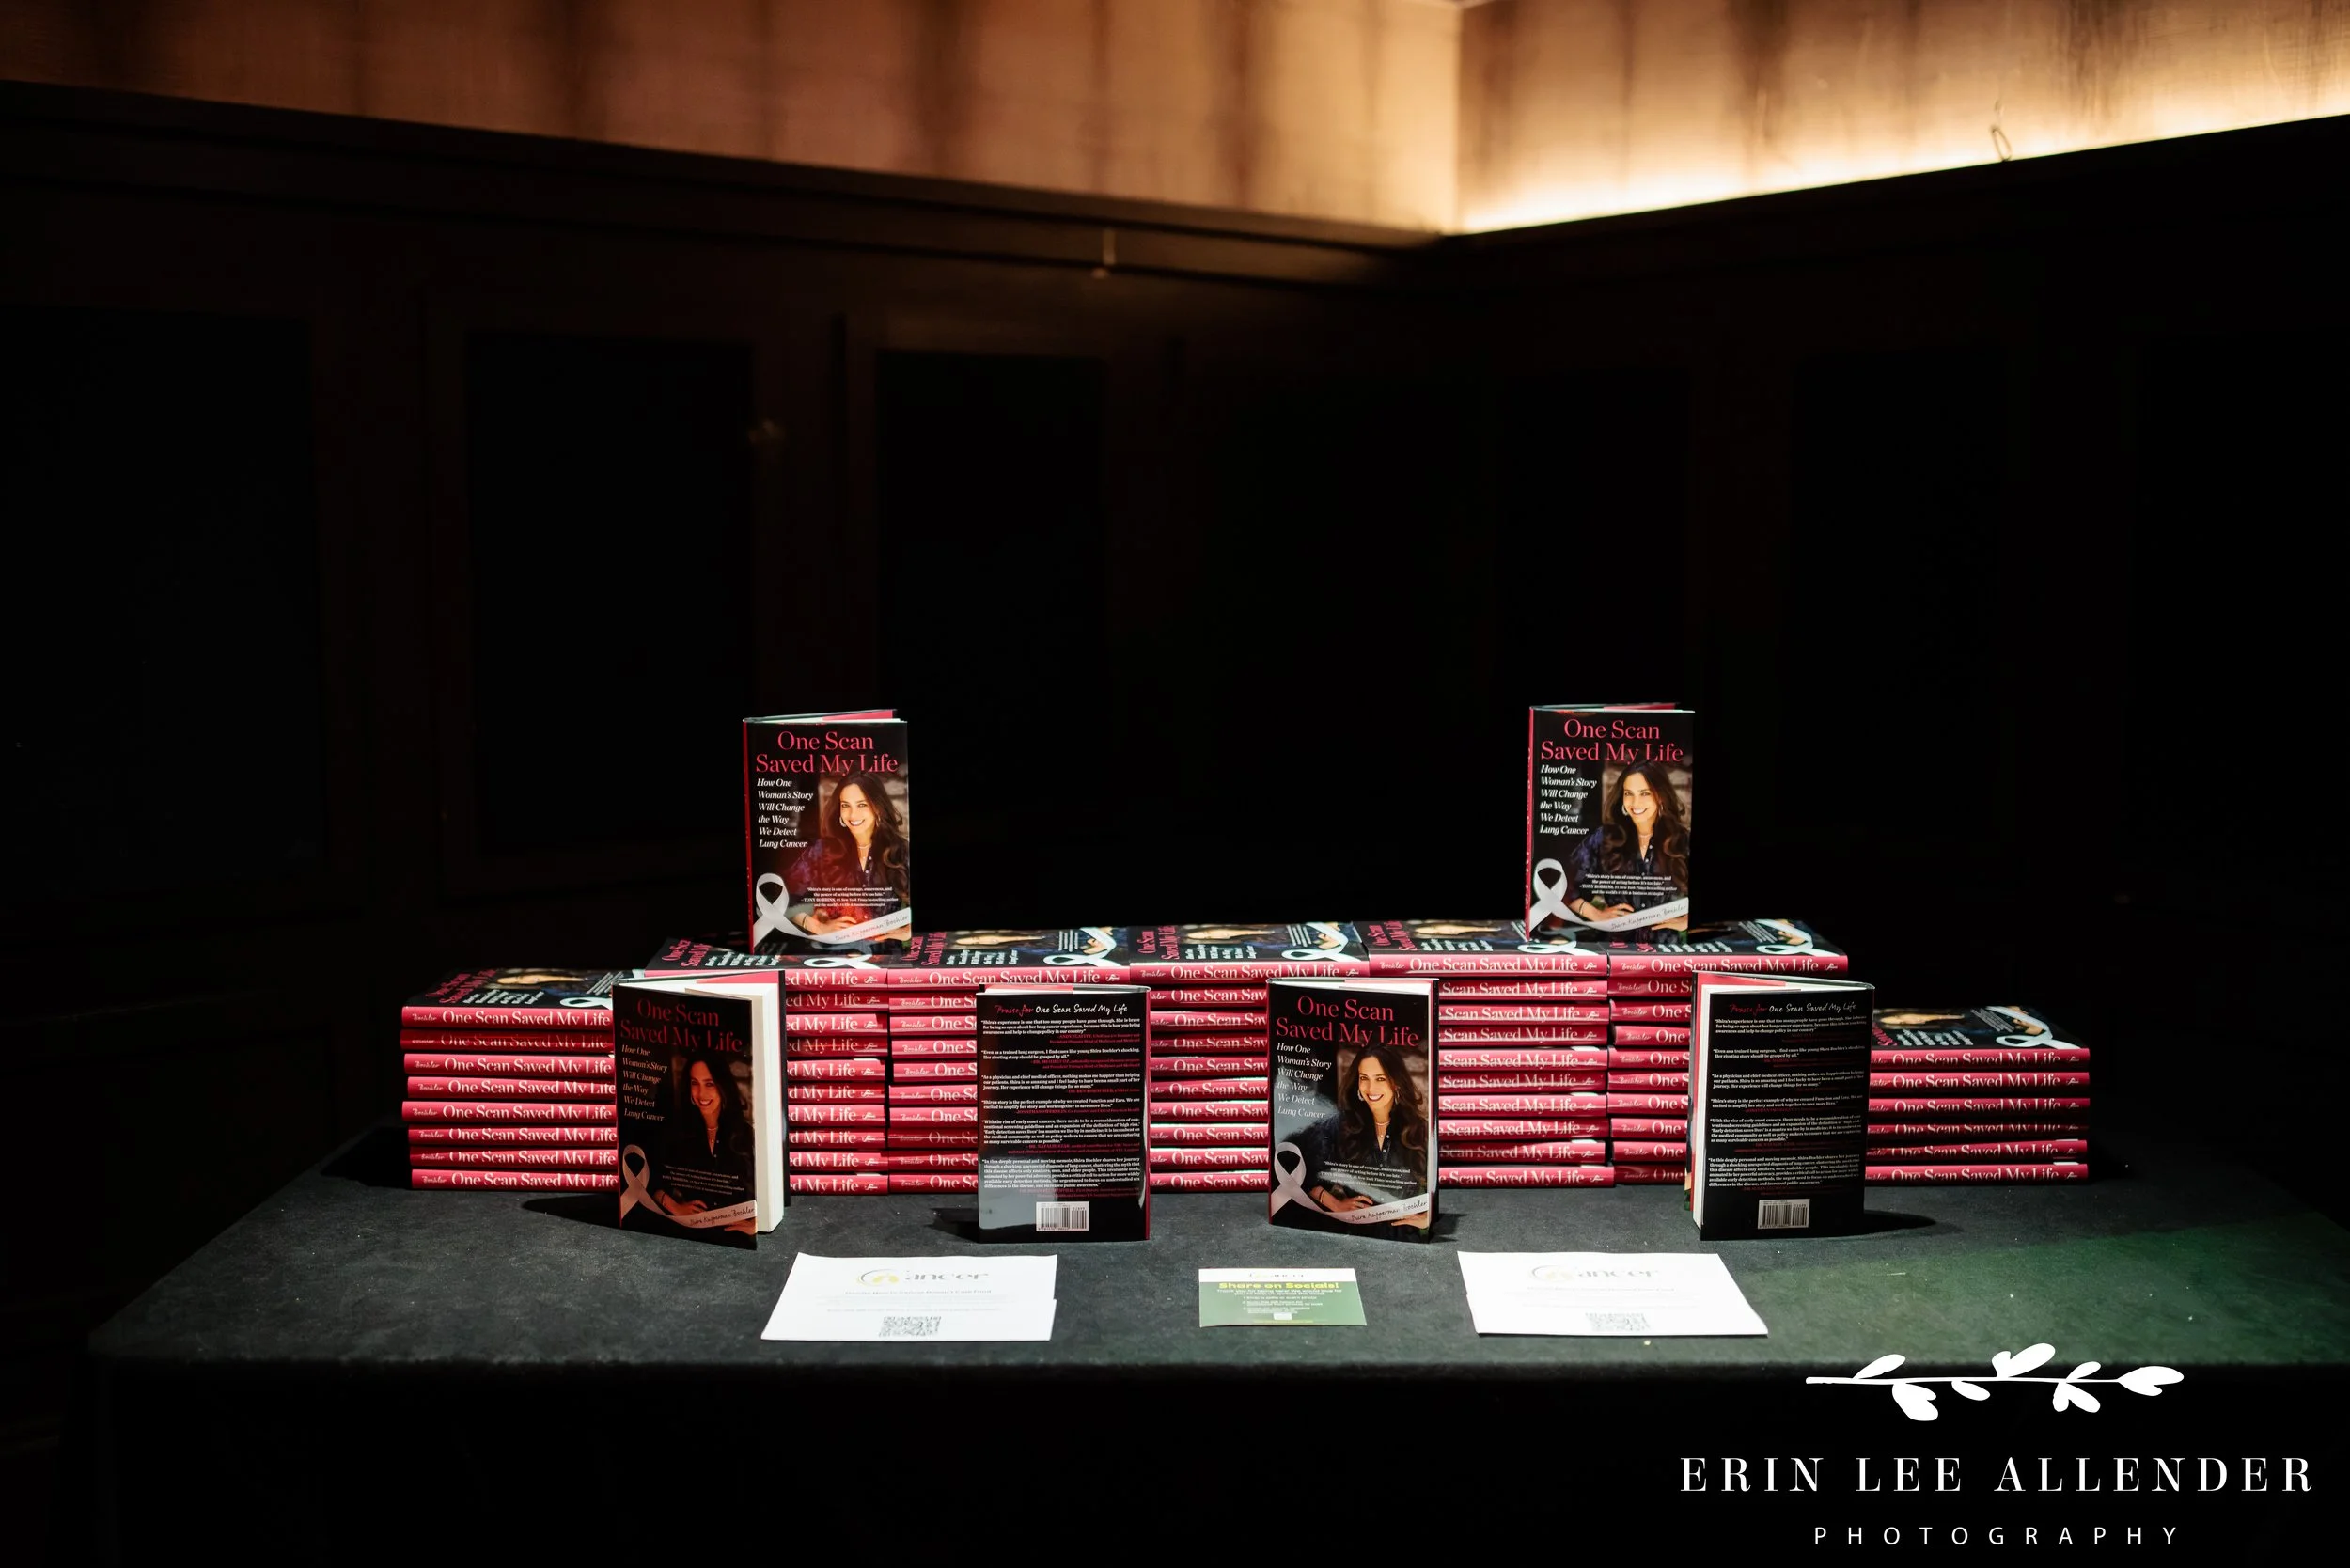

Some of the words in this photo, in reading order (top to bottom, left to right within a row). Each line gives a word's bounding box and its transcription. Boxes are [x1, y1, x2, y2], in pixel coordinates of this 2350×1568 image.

[1564, 719, 1606, 738] One
[1611, 720, 1660, 740] Scan
[777, 730, 820, 750] One
[825, 731, 874, 750] Scan
[1541, 741, 1599, 760] Saved
[1606, 742, 1639, 764] My
[1645, 743, 1684, 761] Life
[756, 754, 814, 773] Saved
[820, 754, 854, 776] My
[859, 753, 898, 773] Life
[1541, 764, 1559, 774] How
[757, 778, 775, 787] How
[776, 778, 792, 787] One
[1541, 777, 1575, 786] Woman's
[1575, 777, 1597, 788] Story
[758, 791, 791, 799] Woman's
[792, 791, 813, 800] Story
[1541, 790, 1558, 798] Will
[1558, 790, 1588, 799] Change
[759, 803, 775, 811] Will
[776, 803, 805, 812] Change
[1540, 801, 1552, 809] the
[1554, 802, 1571, 811] Way
[758, 815, 770, 823] the
[772, 815, 789, 824] Way
[1541, 813, 1553, 822] We
[1554, 813, 1578, 823] Detect
[759, 827, 772, 836] We
[773, 827, 797, 836] Detect
[1540, 825, 1559, 835] Lung
[1560, 825, 1589, 835] Cancer
[759, 839, 778, 849] Lung
[779, 839, 807, 848] Cancer
[1170, 965, 1200, 979] One
[1204, 965, 1238, 979] Scan
[1241, 964, 1282, 978] Saved
[1287, 964, 1309, 977] My
[1314, 964, 1340, 977] Life
[1410, 958, 1439, 971] One
[1442, 957, 1477, 971] Scan
[1480, 957, 1520, 971] Saved
[1525, 957, 1548, 973] My
[1552, 957, 1578, 971] Life
[1651, 959, 1681, 972] One
[1684, 959, 1717, 971] Scan
[1720, 959, 1762, 971] Saved
[1766, 959, 1789, 974] My
[1792, 959, 1819, 971] Life
[804, 969, 826, 986] My
[834, 968, 858, 985] Life
[929, 971, 960, 985] One
[963, 971, 996, 984] Scan
[999, 970, 1042, 984] Saved
[1046, 970, 1070, 983] My
[1073, 969, 1100, 983] Life
[637, 998, 672, 1021] One
[676, 1003, 719, 1027] Scan
[1035, 1005, 1050, 1013] One
[1052, 1004, 1072, 1013] Scan
[1073, 1004, 1096, 1013] Saved
[1097, 1004, 1111, 1015] My
[1113, 1003, 1128, 1014] Life
[1297, 996, 1340, 1018] One
[1344, 999, 1394, 1022] Scan
[1769, 1005, 1783, 1013] One
[1786, 1003, 1804, 1012] Scan
[1806, 1003, 1827, 1011] Saved
[1828, 1003, 1841, 1013] My
[1842, 1001, 1856, 1012] Life
[442, 1011, 472, 1024] One
[475, 1011, 509, 1025] Scan
[511, 1011, 553, 1026] Saved
[557, 1011, 580, 1026] My
[583, 1011, 611, 1027] Life
[620, 1019, 667, 1044] Saved
[673, 1027, 701, 1050] My
[708, 1031, 743, 1053] Life
[1277, 1017, 1333, 1041] Saved
[1339, 1023, 1372, 1047] My
[1380, 1026, 1419, 1046] Life
[621, 1044, 635, 1055] How
[636, 1046, 650, 1056] One
[1277, 1043, 1294, 1052] How
[1295, 1044, 1311, 1054] One
[1277, 1055, 1310, 1067] Woman's
[1310, 1058, 1331, 1070] Story
[1443, 1054, 1477, 1068] Scan
[1480, 1053, 1521, 1068] Saved
[1525, 1053, 1548, 1069] My
[1552, 1053, 1579, 1067] Life
[1277, 1068, 1293, 1077] Will
[1294, 1070, 1324, 1081] Change
[1277, 1081, 1290, 1090] the
[1291, 1082, 1308, 1092] Way
[1892, 1075, 1923, 1089] One
[1925, 1074, 1959, 1088] Scan
[1962, 1074, 2003, 1087] Saved
[2007, 1074, 2029, 1087] My
[2033, 1074, 2060, 1087] Life
[1278, 1093, 1291, 1102] We
[1292, 1095, 1315, 1105] Detect
[1277, 1105, 1297, 1117] Lung
[1297, 1108, 1325, 1119] Cancer
